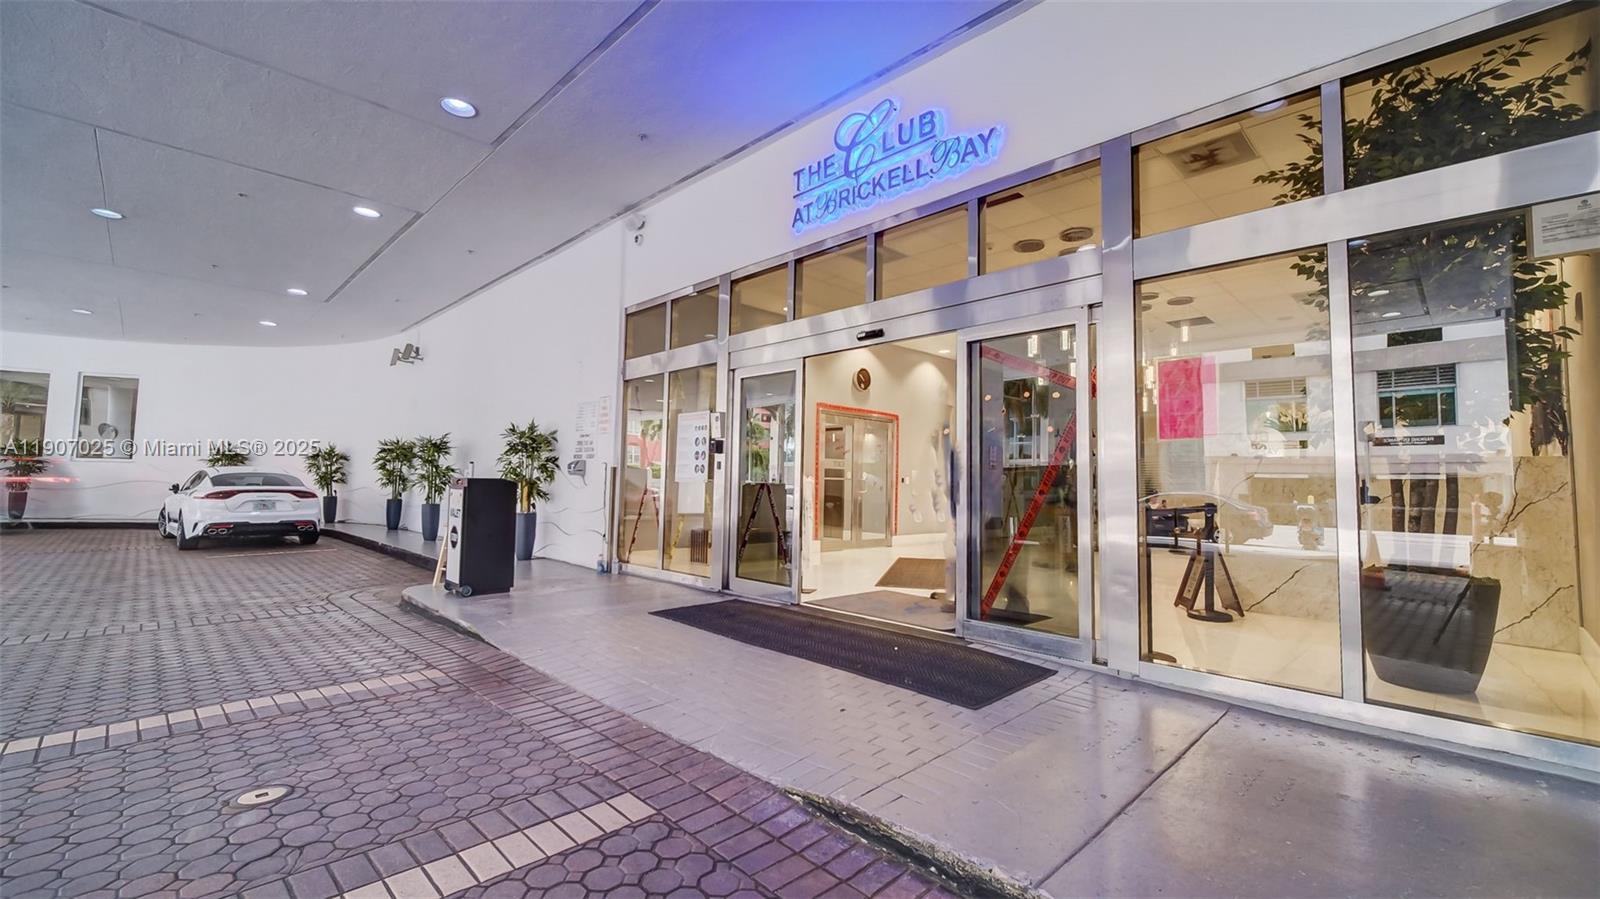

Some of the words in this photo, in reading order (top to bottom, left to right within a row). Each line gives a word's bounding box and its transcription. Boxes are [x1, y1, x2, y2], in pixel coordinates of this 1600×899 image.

[791, 202, 815, 228] AT
[815, 158, 929, 219] BRICKELL
[928, 127, 997, 179] BAY
[792, 153, 835, 191] THE
[834, 98, 937, 183] CLUB
